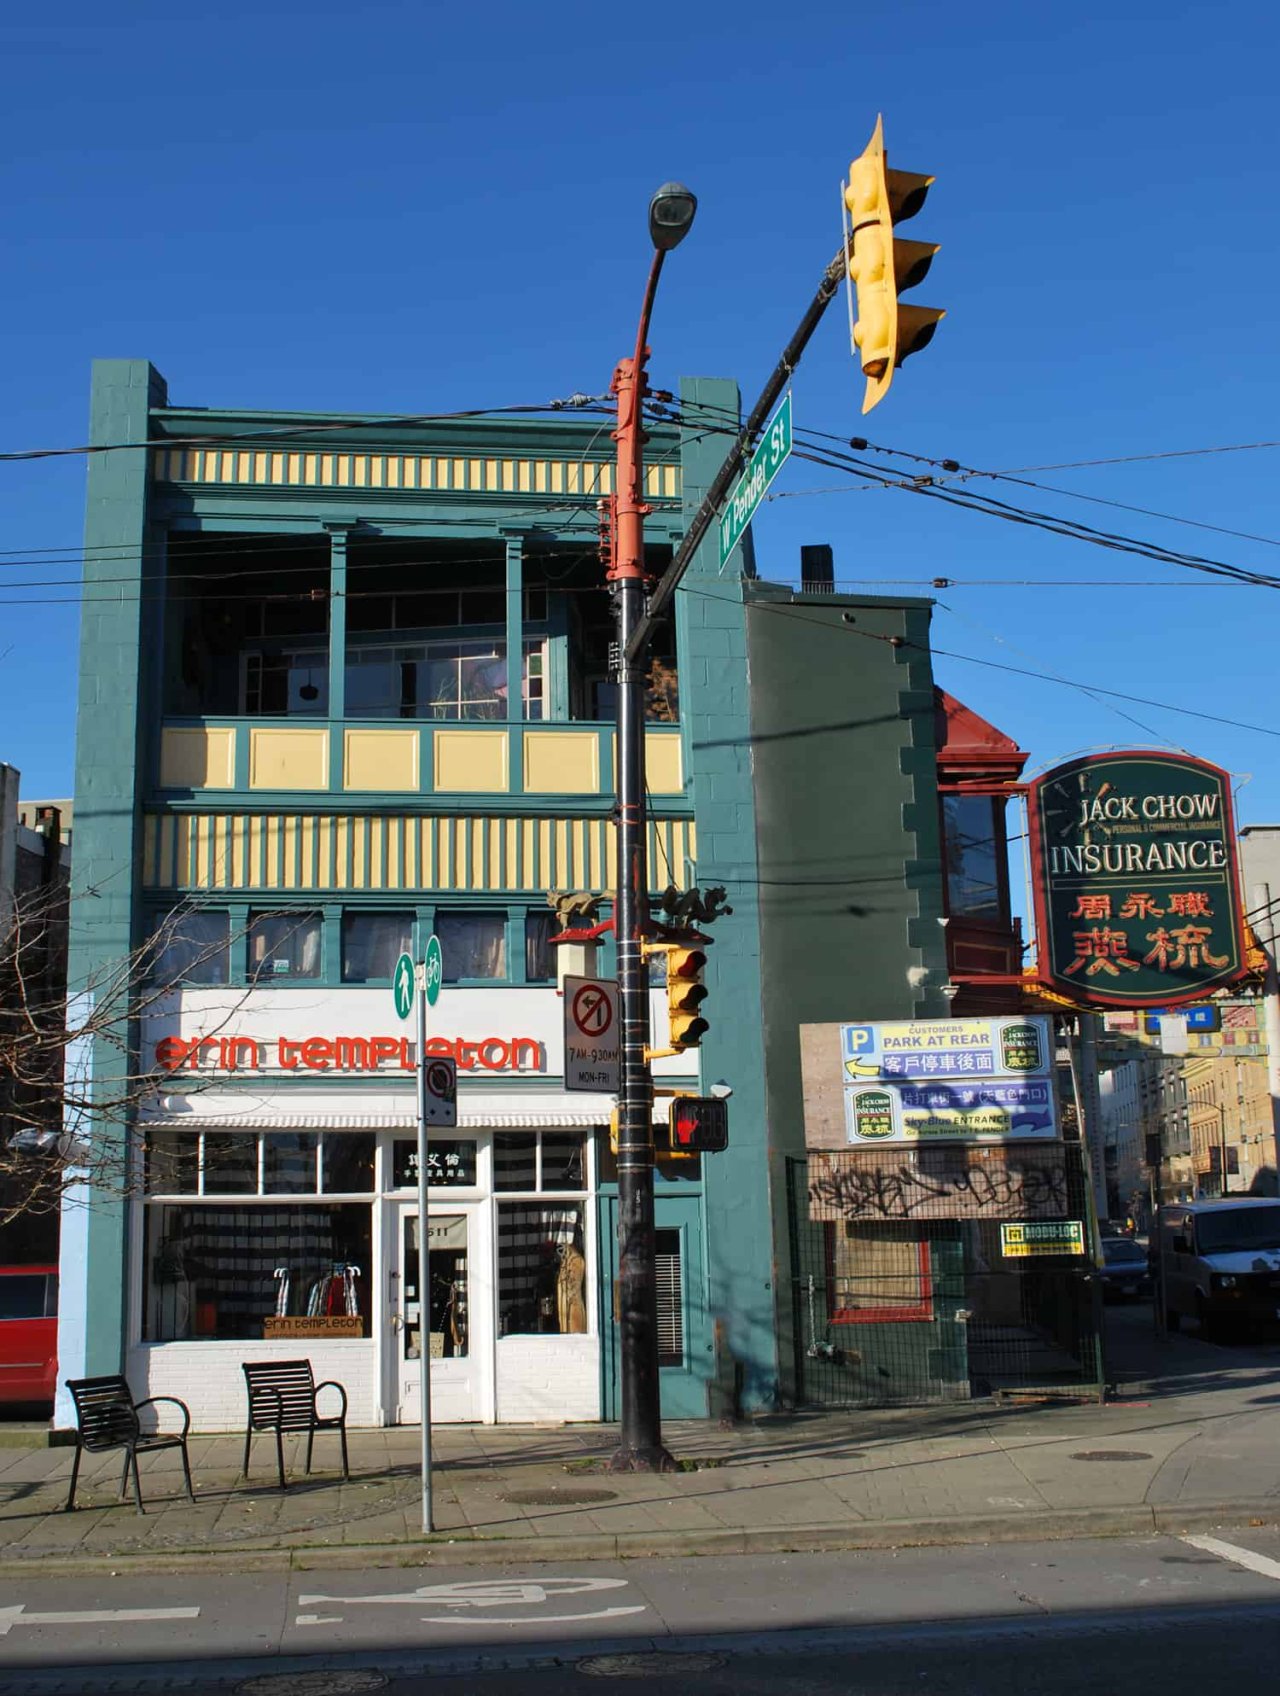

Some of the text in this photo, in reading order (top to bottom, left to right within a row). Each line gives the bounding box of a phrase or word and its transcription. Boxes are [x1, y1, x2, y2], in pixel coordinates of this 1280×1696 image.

[723, 418, 785, 554] W Pender St
[1079, 794, 1218, 828] JACK CHOW
[1050, 840, 1227, 873] INSURANCE
[1063, 924, 1230, 976] 燕梳
[908, 1025, 964, 1034] CUSTOMERS
[852, 1030, 869, 1051] P
[883, 1033, 990, 1048] PARK AT REAR
[155, 1036, 540, 1071] erin templeton
[884, 1052, 992, 1073] 客戶停車後面
[903, 1115, 1010, 1128] Sky-Blue ENTRANCE
[265, 1318, 291, 1330] erin
